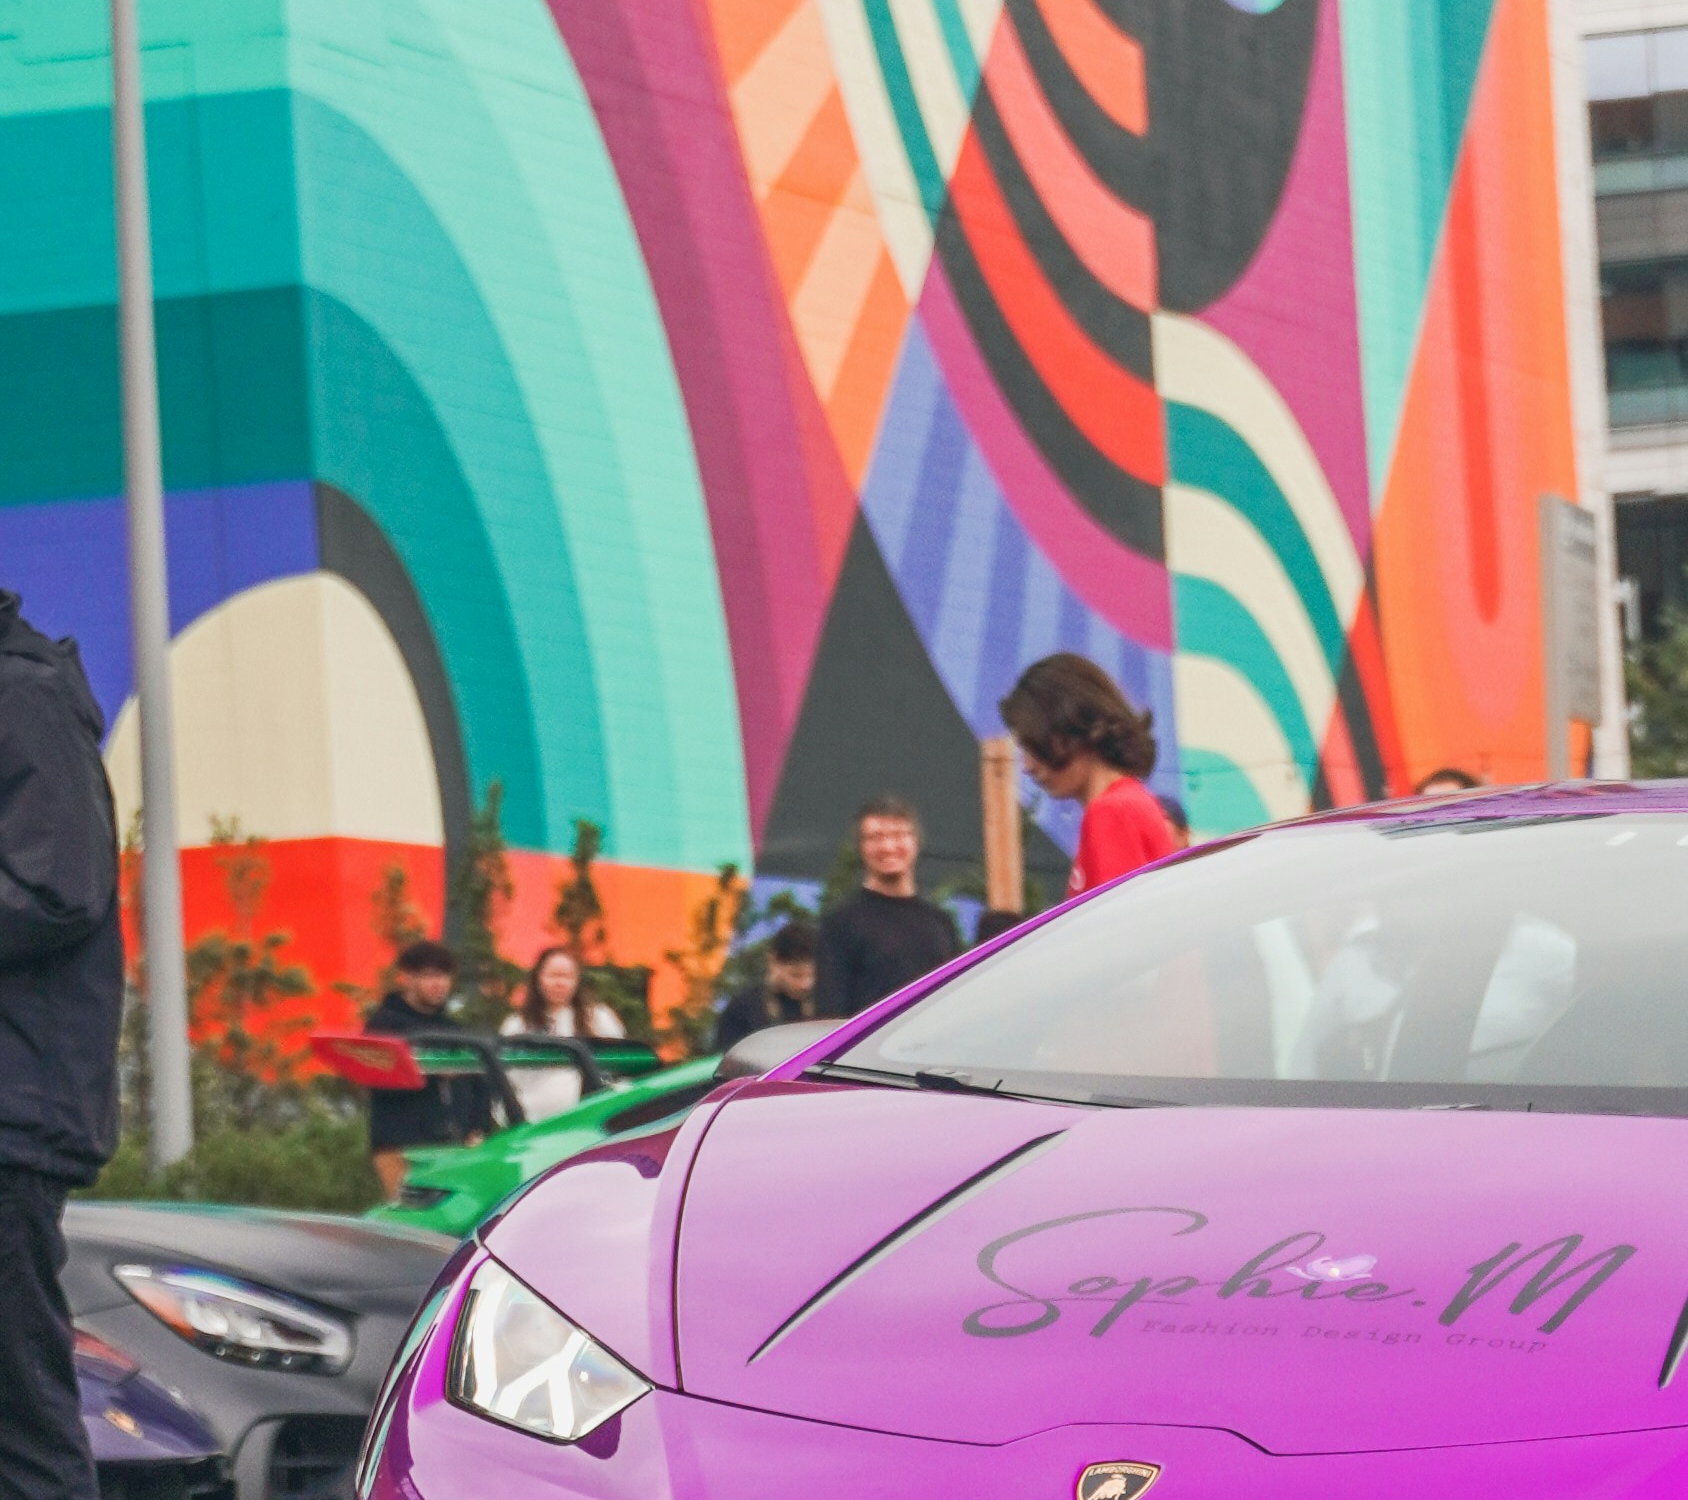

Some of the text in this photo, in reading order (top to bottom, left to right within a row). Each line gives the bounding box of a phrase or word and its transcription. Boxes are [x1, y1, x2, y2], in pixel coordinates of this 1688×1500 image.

[1139, 1318, 1548, 1356] Fashion Design Group
[1088, 1466, 1152, 1478] LAMBORGHINI
